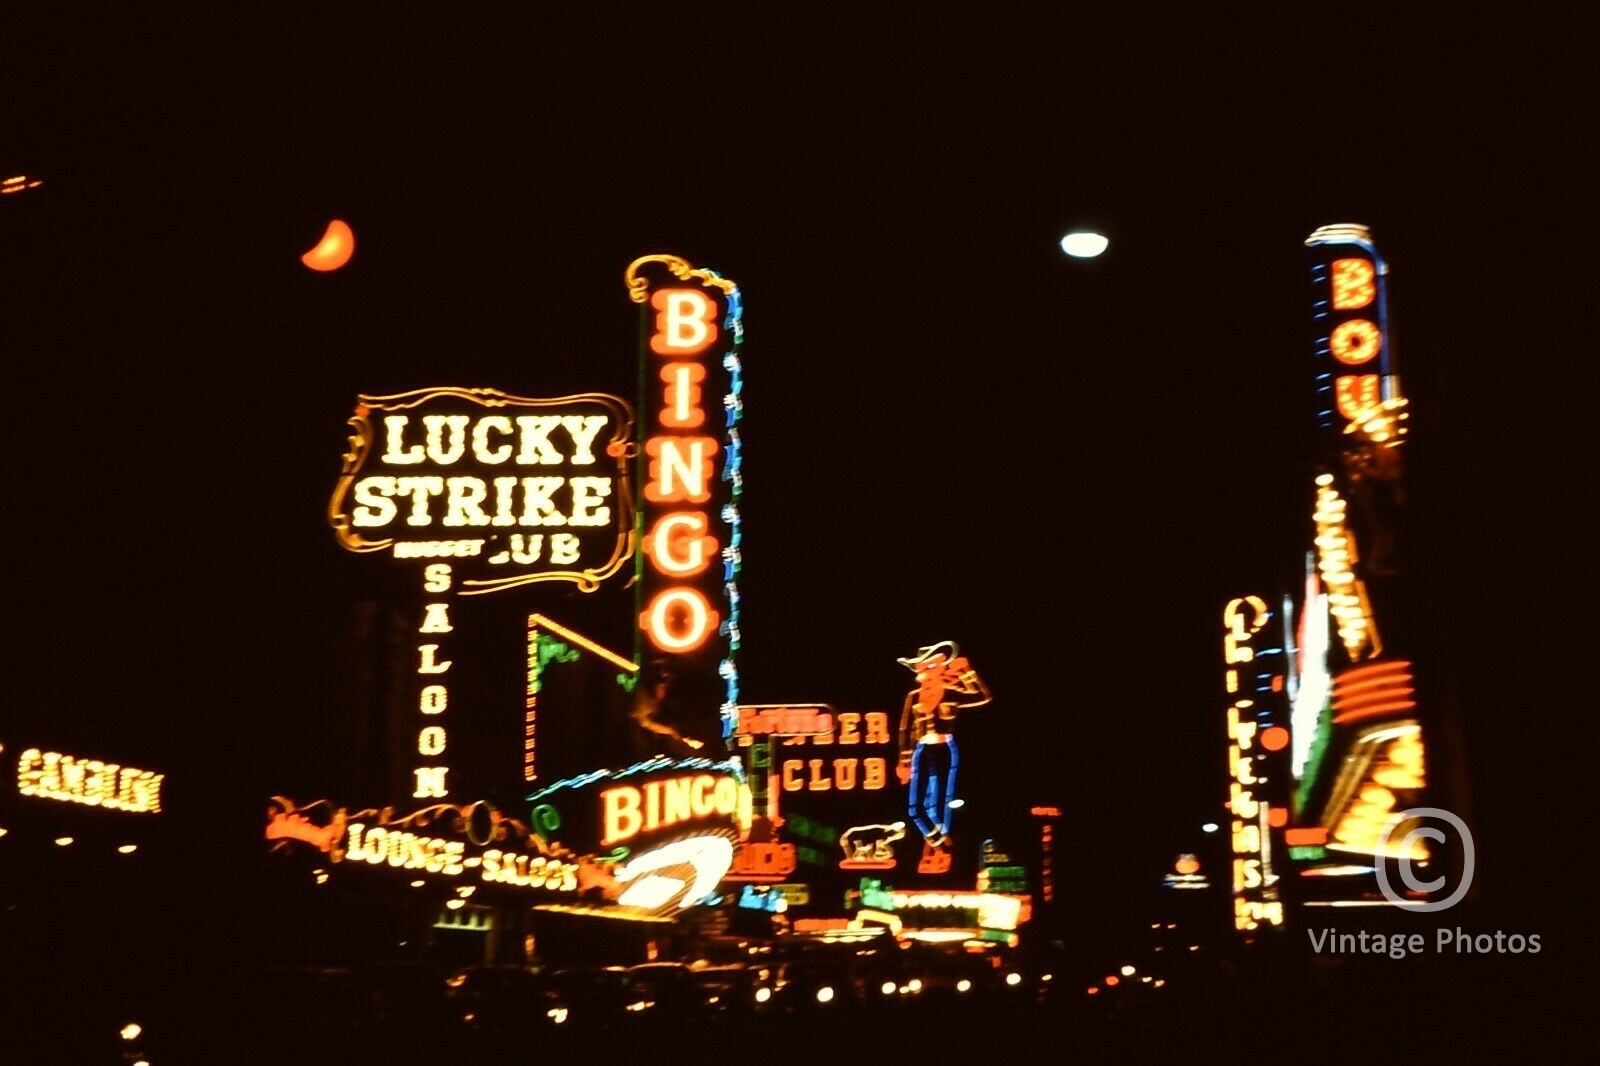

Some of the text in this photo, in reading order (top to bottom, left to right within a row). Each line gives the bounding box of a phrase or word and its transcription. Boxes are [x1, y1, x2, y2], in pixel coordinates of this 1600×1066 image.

[381, 415, 608, 465] LUCKY
[352, 476, 612, 526] STRIKE
[642, 290, 719, 652] BINGO
[413, 563, 453, 798] SALOON
[783, 757, 887, 792] CLUB
[601, 774, 738, 846] BINGO
